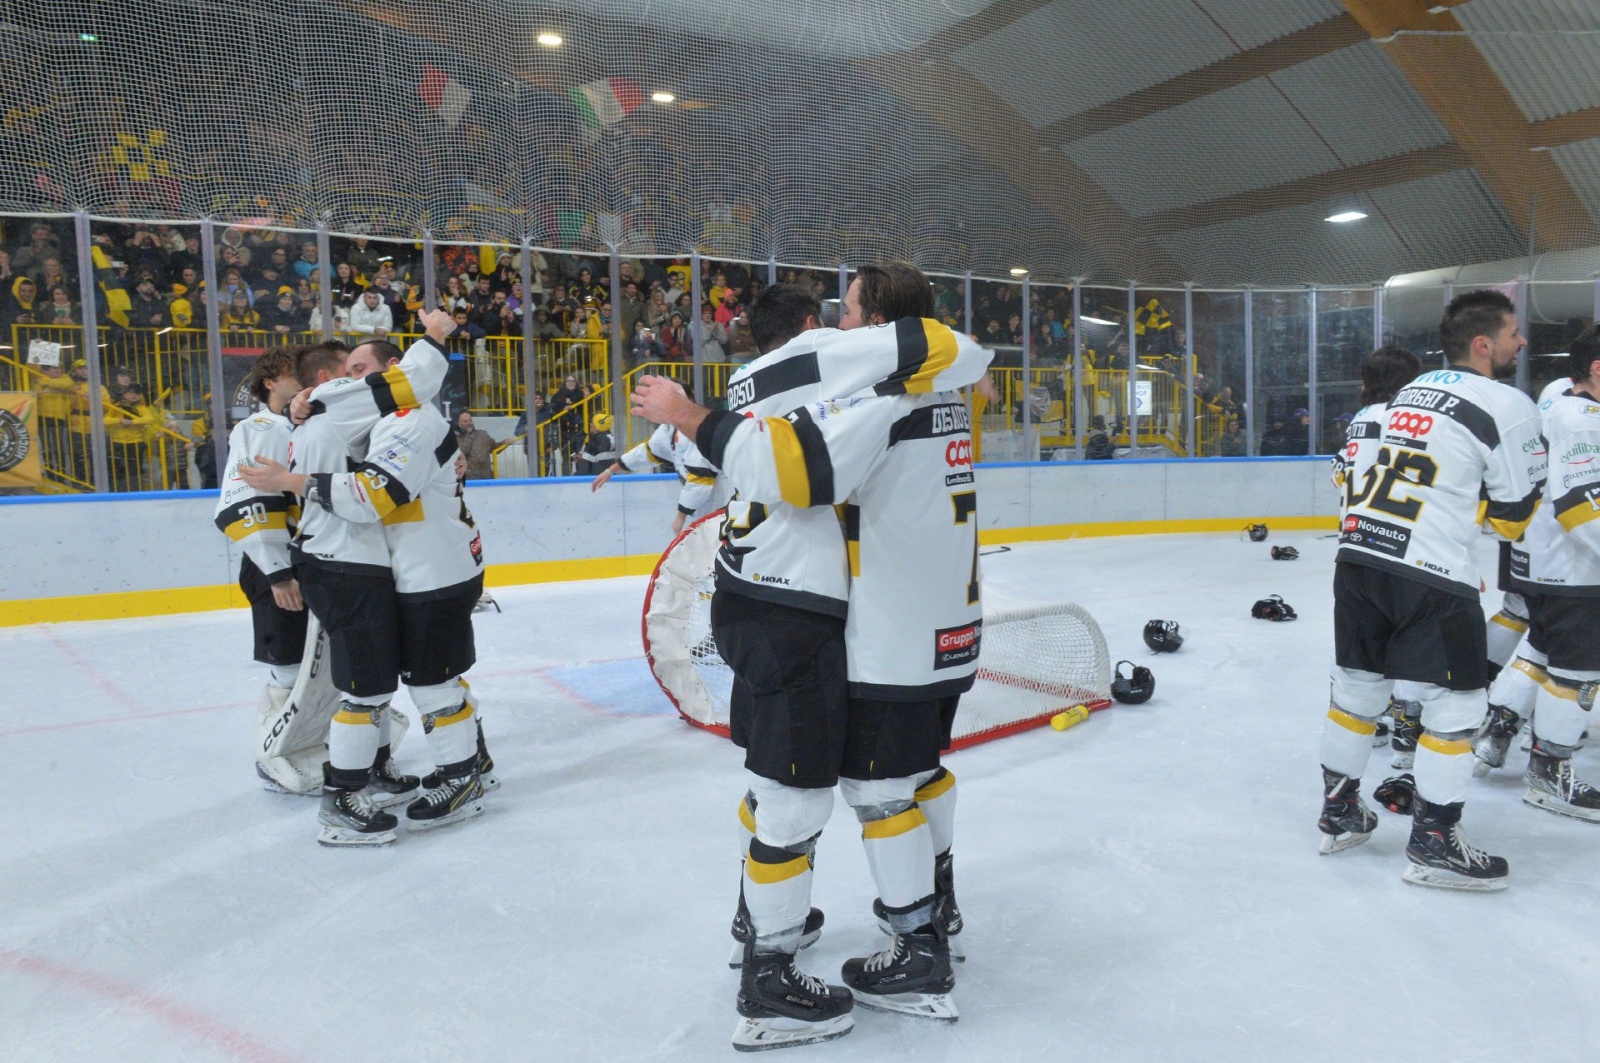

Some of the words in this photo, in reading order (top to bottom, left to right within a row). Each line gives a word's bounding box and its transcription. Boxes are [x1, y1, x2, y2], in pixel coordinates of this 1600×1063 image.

[1438, 396, 1460, 416] P.
[14, 423, 29, 459] HOCKEY
[238, 502, 268, 528] 30
[1358, 520, 1406, 541] Novauto
[1424, 562, 1451, 575] HOAX
[761, 576, 791, 585] HOAX
[263, 702, 299, 752] CCM
[785, 994, 815, 1007] BAUER
